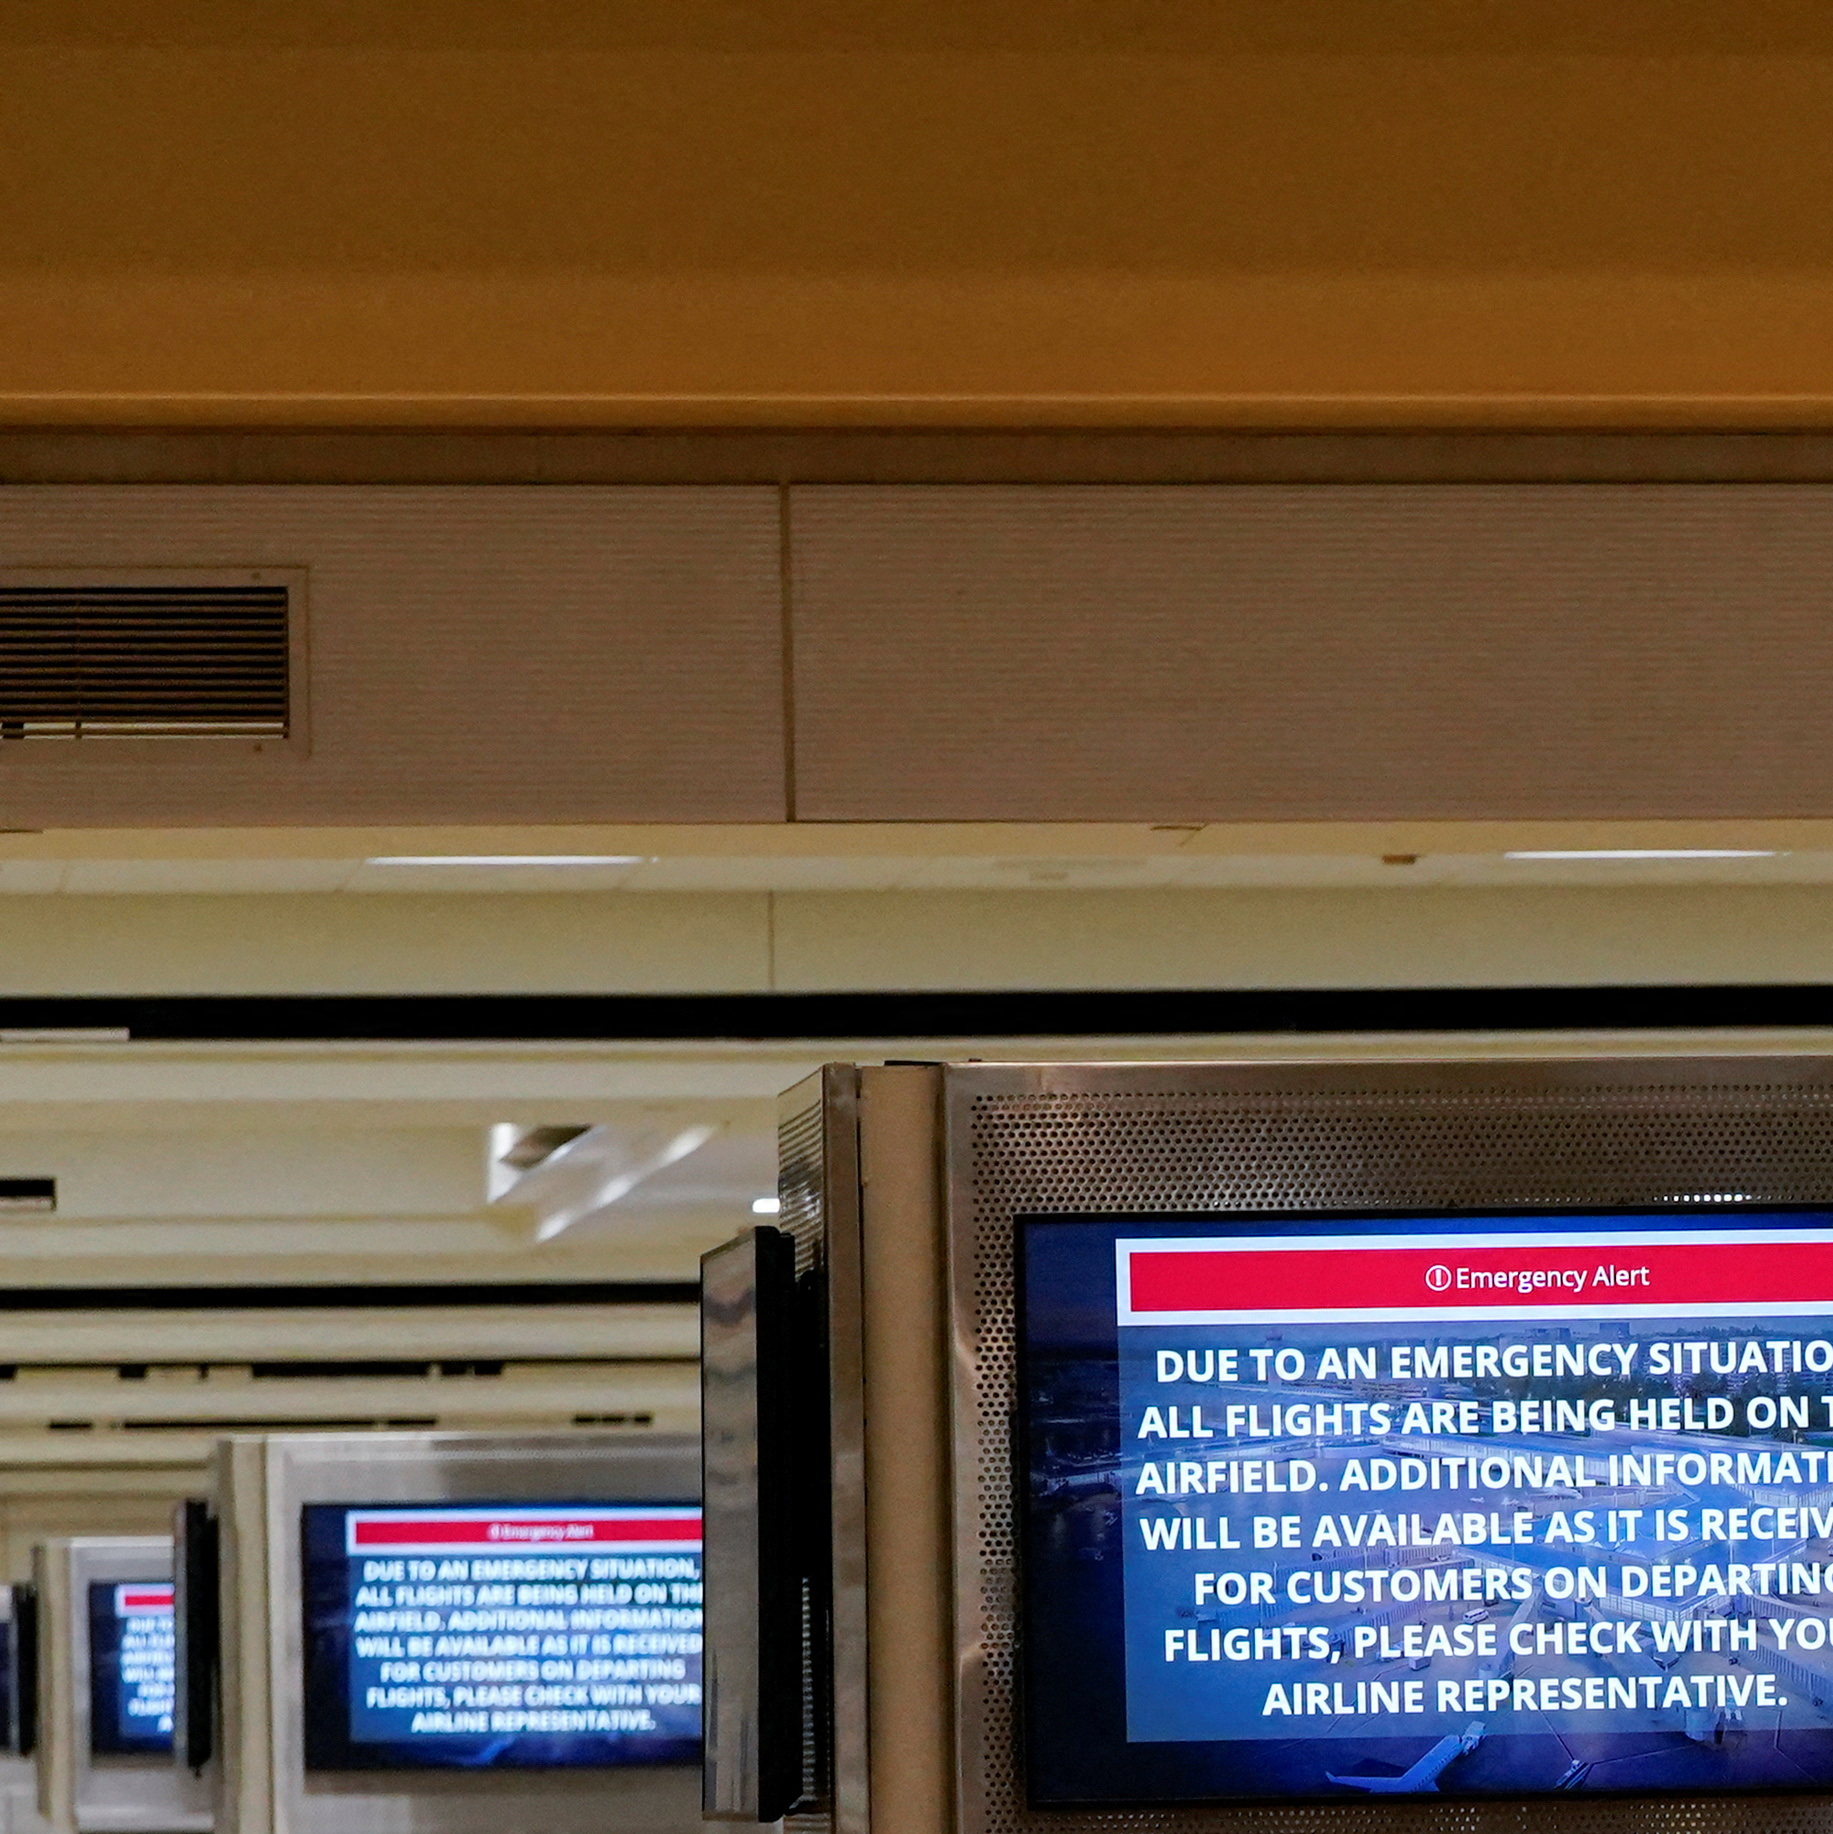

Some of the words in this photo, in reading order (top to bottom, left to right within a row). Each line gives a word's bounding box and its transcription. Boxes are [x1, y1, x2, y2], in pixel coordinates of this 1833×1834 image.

[1456, 1267, 1588, 1294] Emergency
[1591, 1264, 1651, 1287] Alert
[1156, 1349, 1239, 1383] DUE
[1248, 1348, 1306, 1382] TO
[1315, 1347, 1377, 1381] AN
[1391, 1342, 1639, 1381] EMERGENCY
[1137, 1405, 1214, 1439] ALL
[1226, 1402, 1391, 1437] FLIGHTS
[1401, 1401, 1479, 1435] ARE
[1492, 1399, 1615, 1433] BEING
[1630, 1397, 1734, 1431] HELD
[1746, 1396, 1809, 1429] ON
[1135, 1460, 1328, 1495] AIRFIELD.
[1339, 1455, 1597, 1491] ADDITIONAL
[1139, 1516, 1241, 1551] WILL
[1253, 1515, 1302, 1549] BE
[1311, 1511, 1535, 1546] AVAILABLE
[1544, 1511, 1597, 1543] AS
[1608, 1510, 1642, 1542] IT
[1656, 1510, 1690, 1542] IS
[363, 1560, 406, 1582] DUE
[407, 1559, 437, 1582] TO
[437, 1559, 469, 1582] AN
[470, 1558, 589, 1581] EMERGENCY
[589, 1557, 702, 1581] SITUATION,
[1195, 1572, 1276, 1605] FOR
[1287, 1567, 1534, 1604] CUSTOMERS
[1544, 1566, 1607, 1603] ON
[1165, 1626, 1341, 1664] FLIGHTS,
[1354, 1624, 1497, 1659] PLEASE
[1508, 1620, 1643, 1656] CHECK
[1650, 1617, 1758, 1653] WITH
[380, 1661, 421, 1682] FOR
[422, 1660, 540, 1683] CUSTOMERS
[540, 1660, 574, 1681] ON
[575, 1658, 687, 1683] DEPARTING
[1262, 1680, 1425, 1716] AIRLINE
[1436, 1672, 1788, 1714] REPRESENTATIVE.
[411, 1710, 490, 1733] AIRLINE
[490, 1709, 657, 1732] REPRESENTATIVE.
